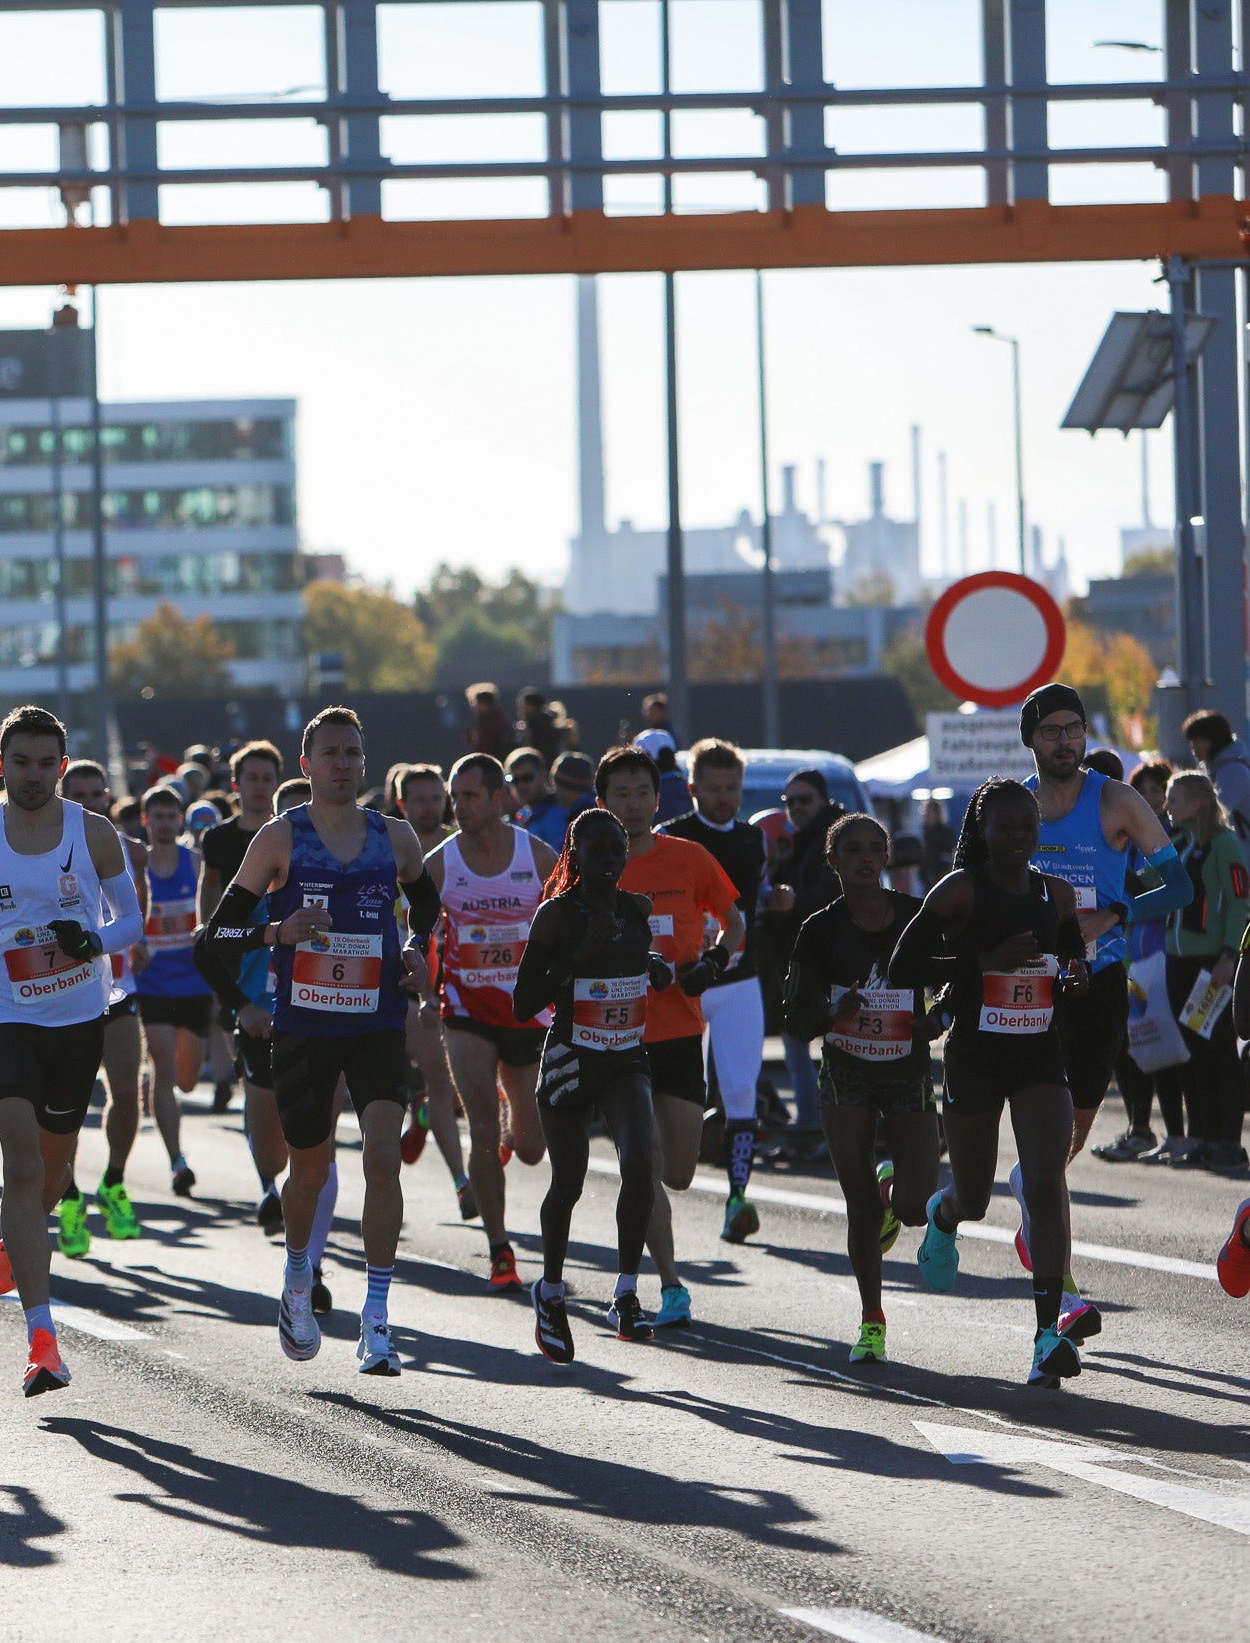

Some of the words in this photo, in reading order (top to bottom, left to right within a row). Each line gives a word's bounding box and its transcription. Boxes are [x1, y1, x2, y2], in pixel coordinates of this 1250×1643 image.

[1035, 860, 1051, 870] AV
[1052, 863, 1094, 871] Stadtwerke
[461, 897, 522, 912] AUSTRIA
[214, 926, 245, 938] TERREX
[44, 951, 55, 968] 7
[480, 949, 512, 964] 726
[332, 963, 344, 981] 6
[20, 967, 90, 997] Oberbank
[298, 988, 370, 1007] Oberbank
[1013, 985, 1033, 1003] F6
[606, 1008, 629, 1024] F5
[986, 1012, 1049, 1028] Oberbank
[858, 1017, 882, 1034] F3
[833, 1038, 903, 1056] Oberbank
